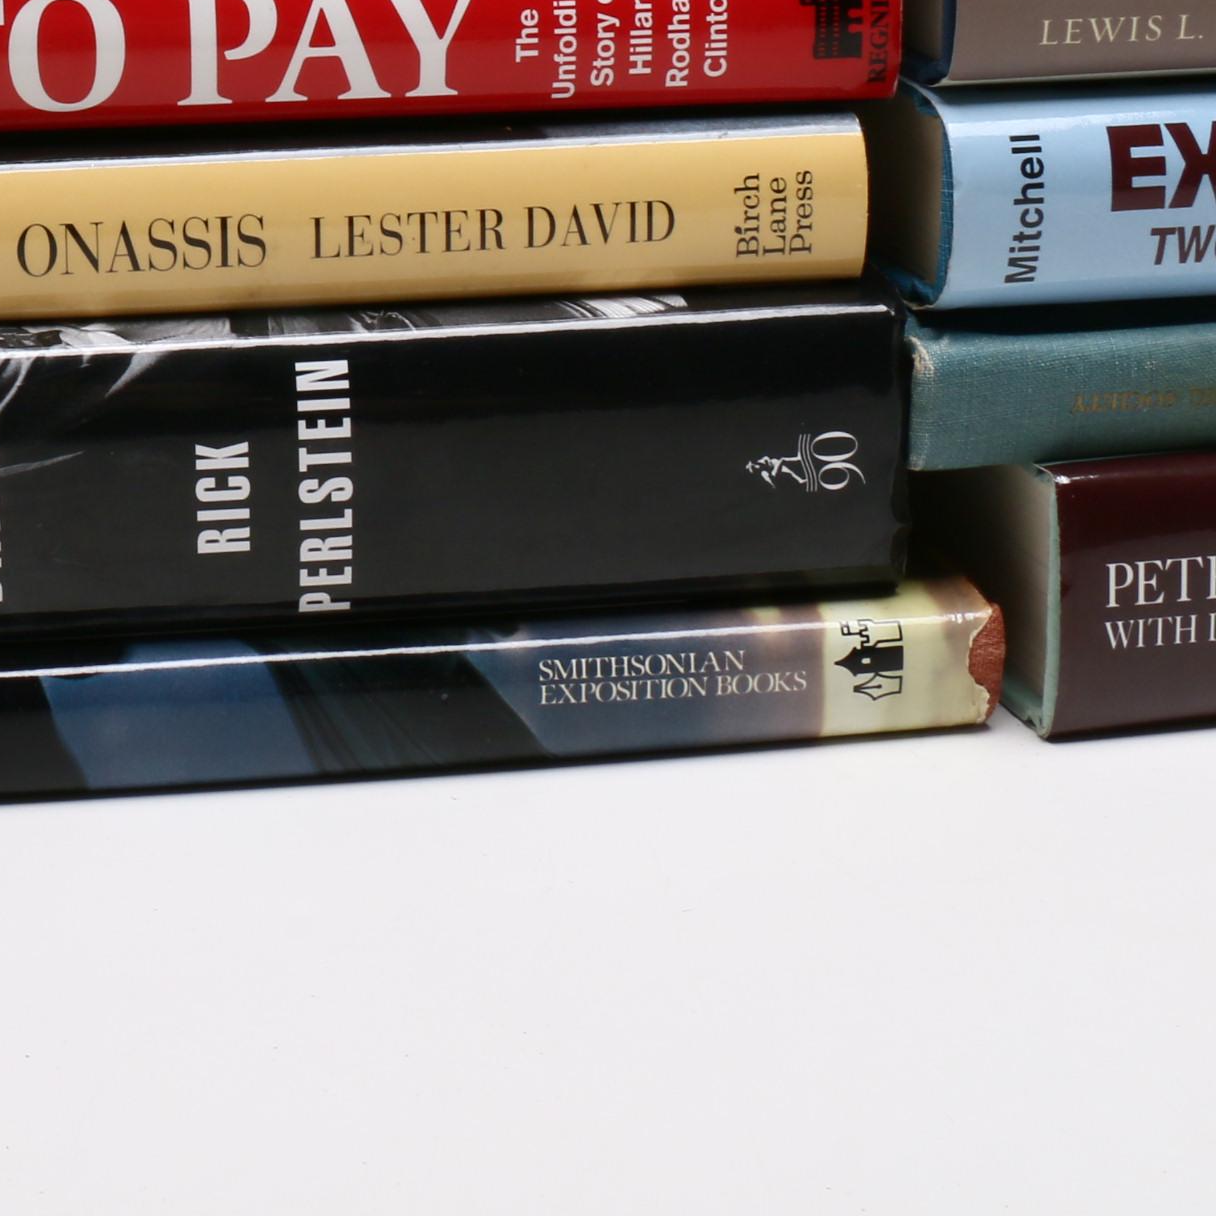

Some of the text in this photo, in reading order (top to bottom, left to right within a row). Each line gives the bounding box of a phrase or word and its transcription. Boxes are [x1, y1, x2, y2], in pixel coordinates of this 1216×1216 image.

[515, 8, 539, 63] The
[590, 12, 620, 87] Story
[1039, 13, 1204, 46] LEWIS L.
[16, 214, 267, 278] ONASSIS
[309, 209, 506, 260] LESTER
[523, 200, 677, 249] DAVID
[733, 172, 760, 258] Birch
[762, 176, 788, 257] Lane
[788, 169, 814, 256] Press
[1004, 134, 1045, 284] Mitchell
[194, 441, 251, 554] RICK
[294, 359, 354, 613] PERLSTEIN
[537, 649, 747, 683] SMITHSONIAN
[1104, 613, 1198, 651] WITH
[537, 669, 808, 706] EXPOSITION BOOKS
